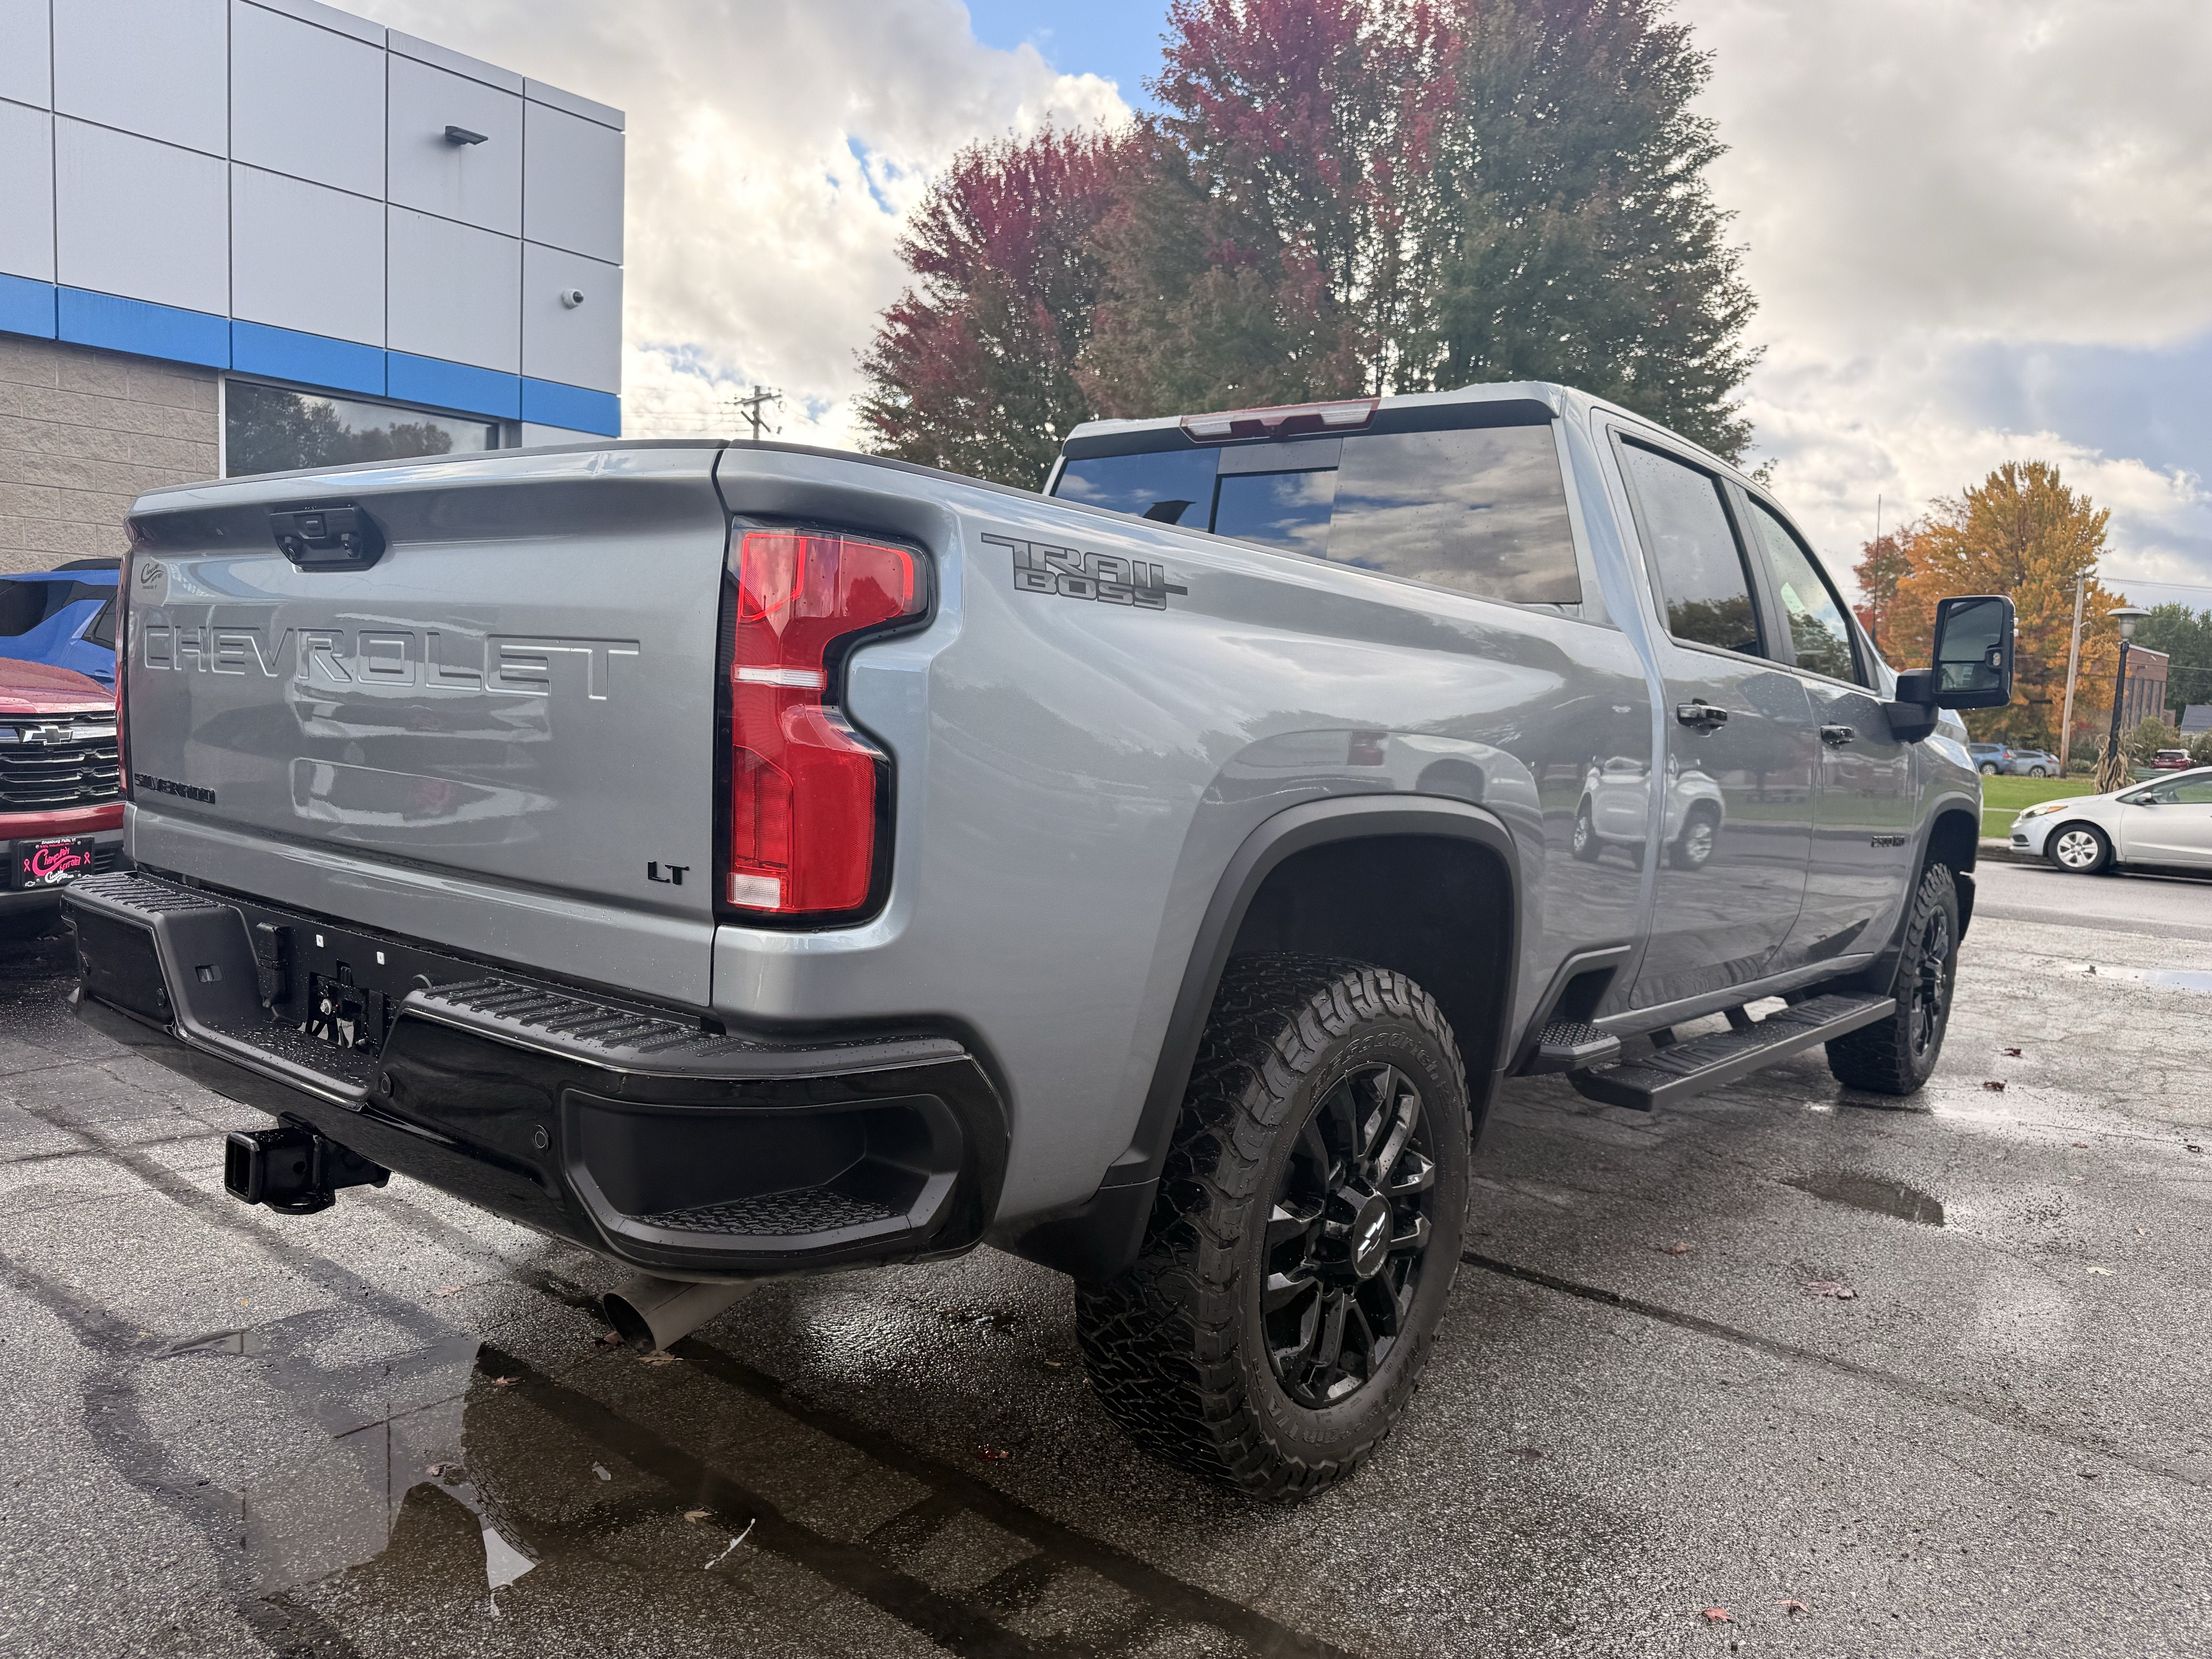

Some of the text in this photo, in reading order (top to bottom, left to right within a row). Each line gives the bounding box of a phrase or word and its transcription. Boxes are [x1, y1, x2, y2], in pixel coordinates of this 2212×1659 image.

[981, 532, 1188, 595] TRAIL
[1014, 566, 1167, 611] BOSS
[144, 625, 640, 699] CHEVROLET
[647, 861, 690, 885] LT
